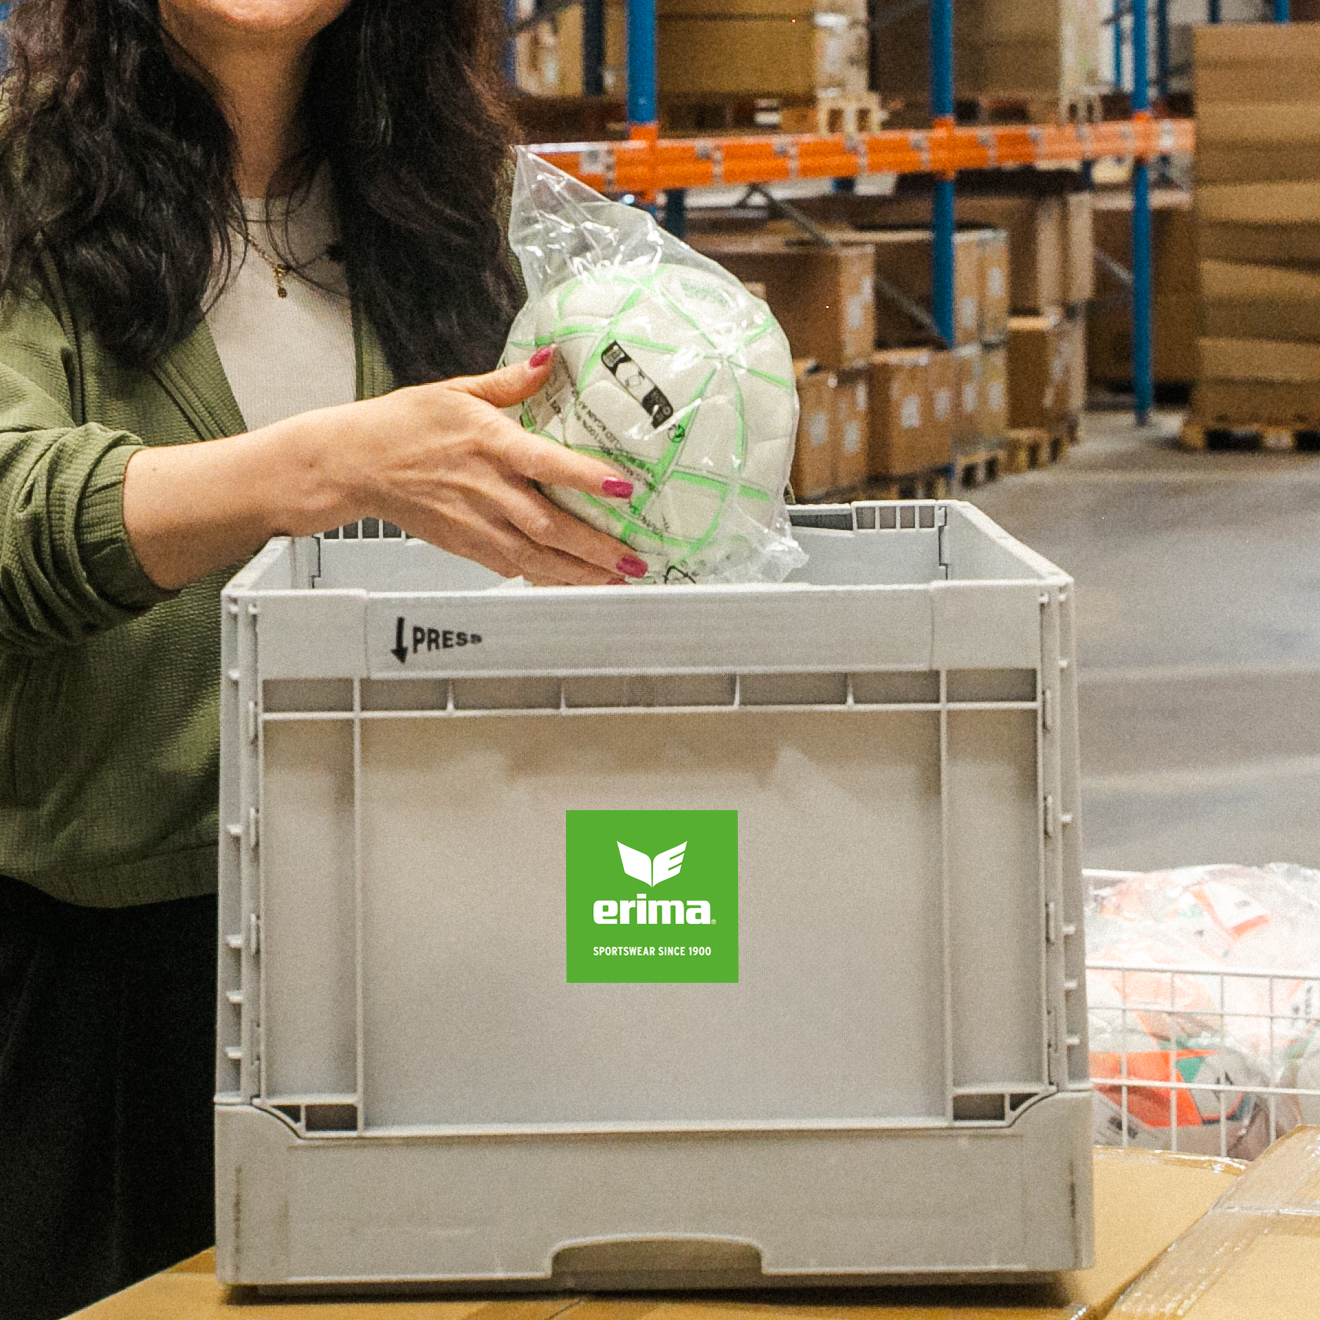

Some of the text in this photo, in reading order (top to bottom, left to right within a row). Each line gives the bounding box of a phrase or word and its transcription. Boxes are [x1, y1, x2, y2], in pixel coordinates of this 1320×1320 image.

[592, 893, 711, 925] erima
[592, 946, 712, 957] SPORTSWEAR SINCE 1900
